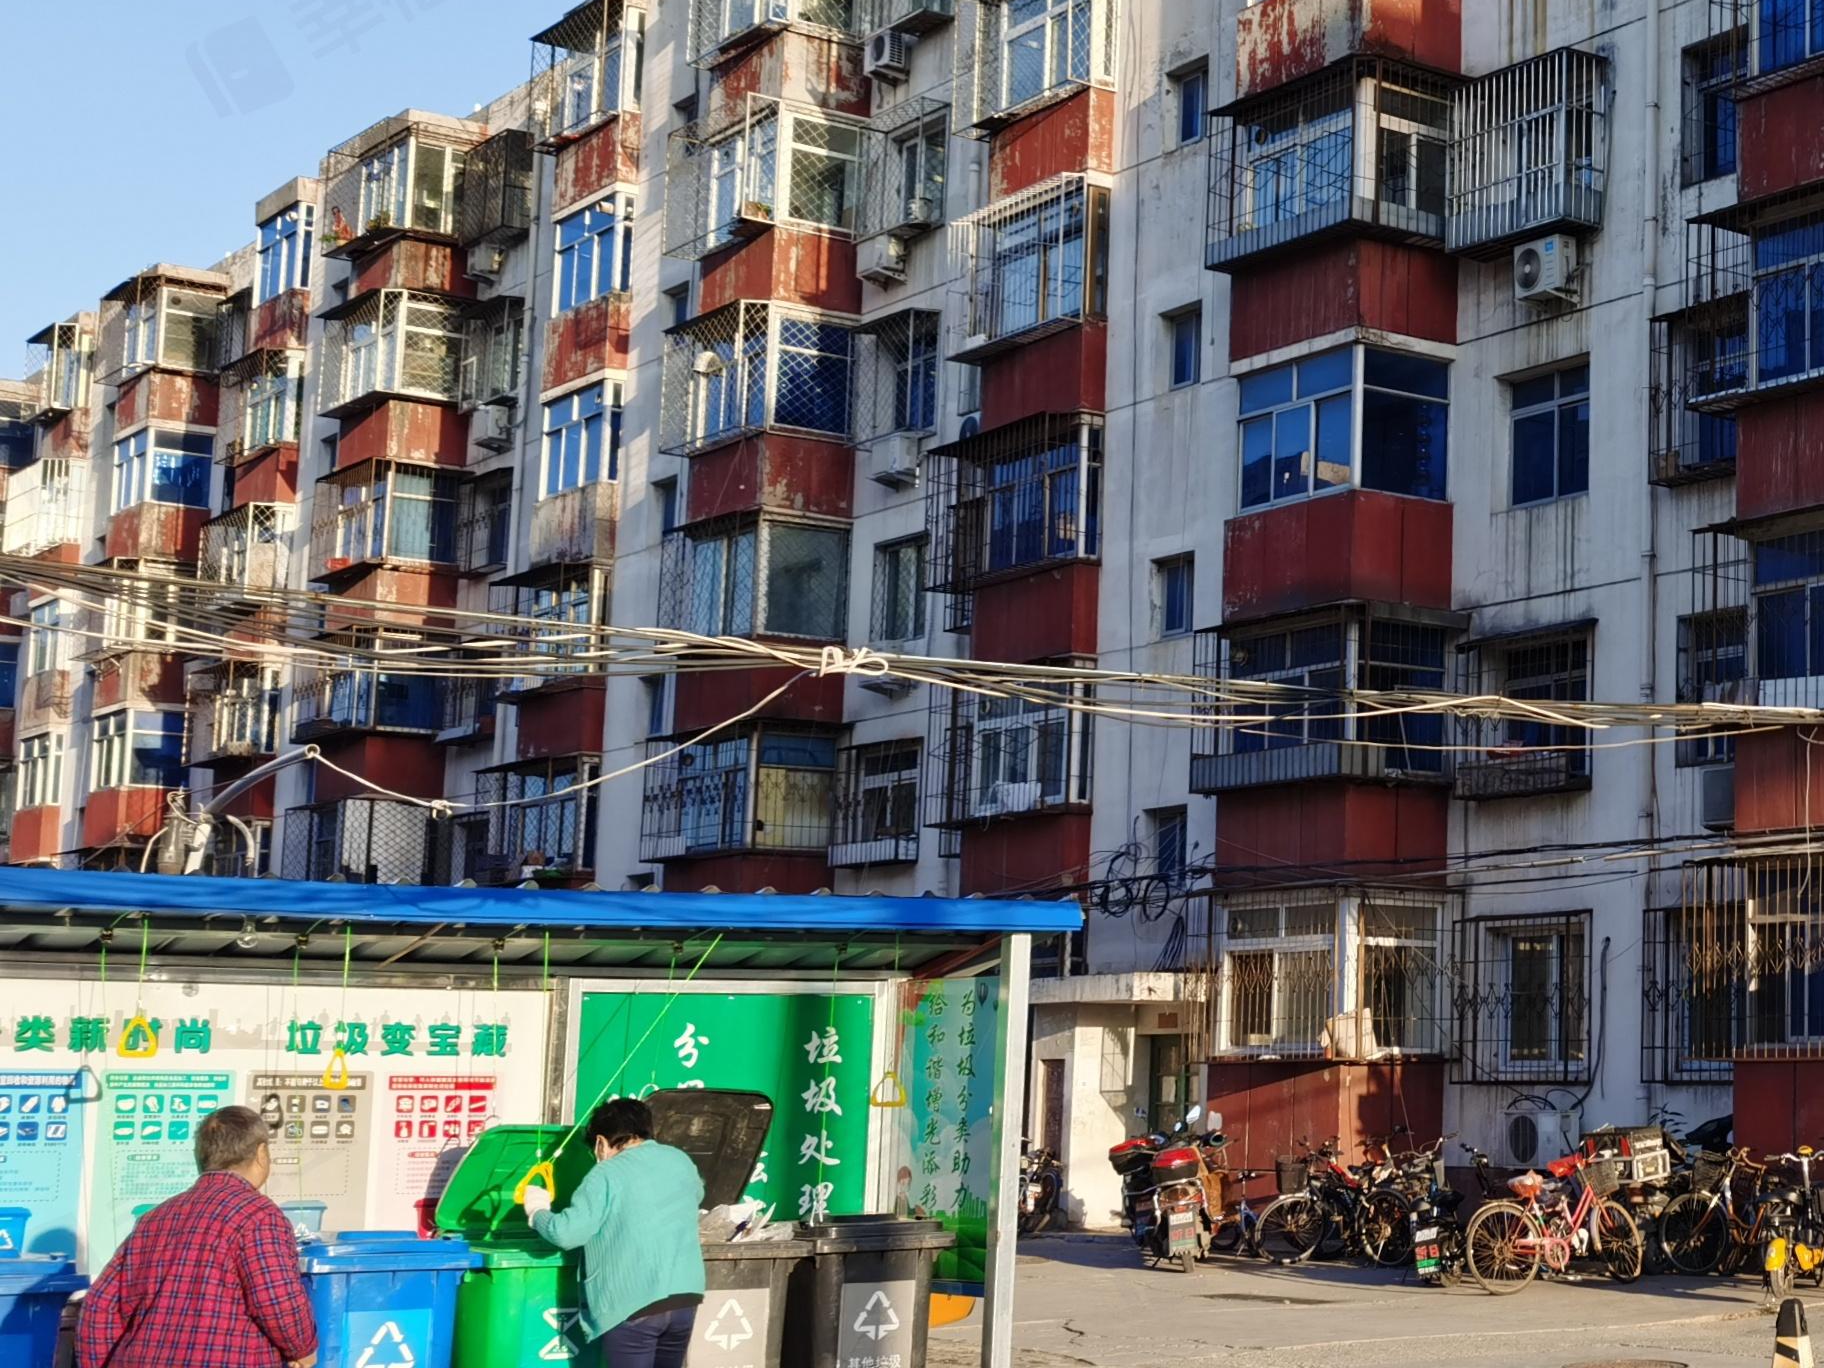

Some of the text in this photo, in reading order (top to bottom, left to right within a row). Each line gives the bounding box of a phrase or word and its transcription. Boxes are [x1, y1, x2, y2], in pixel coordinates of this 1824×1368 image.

[0, 1015, 212, 1054] 类新时尚
[285, 1019, 508, 1057] 垃圾变宝藏
[798, 1027, 843, 1224] 垃圾处理
